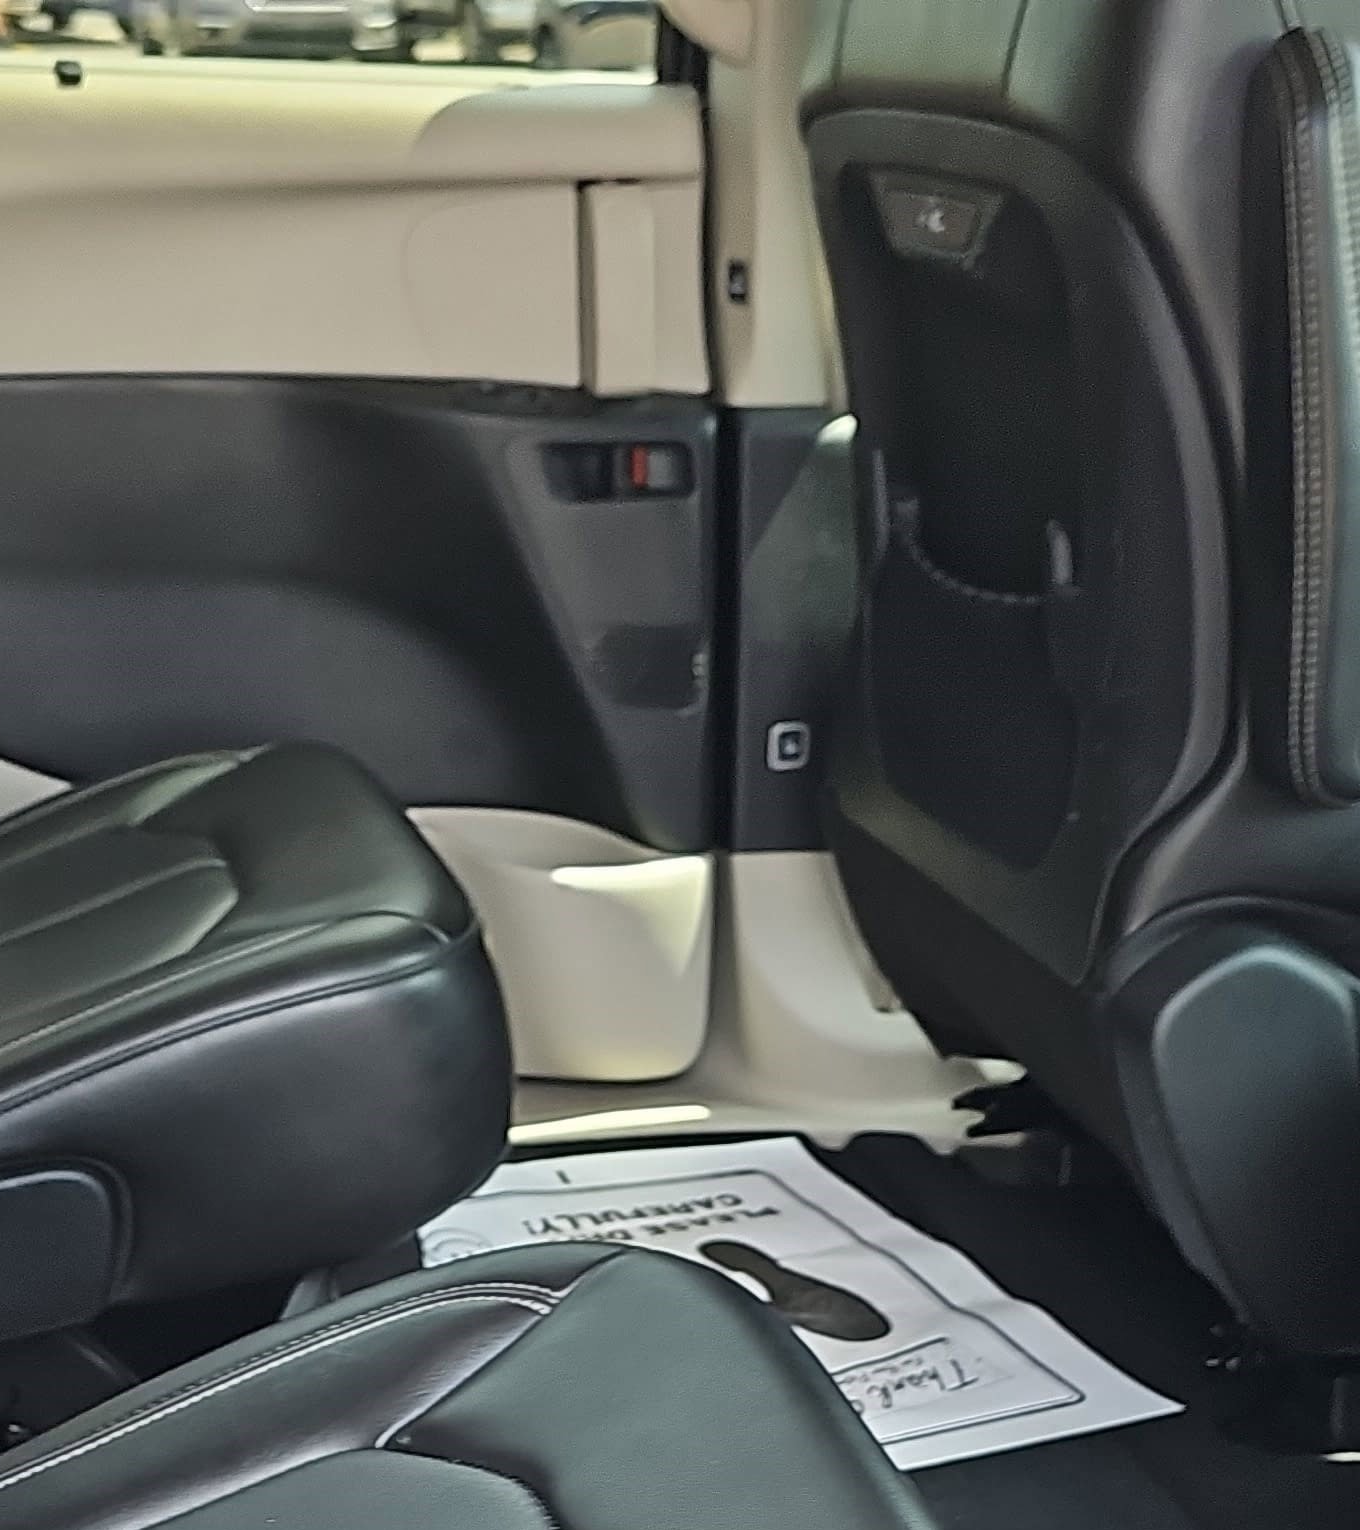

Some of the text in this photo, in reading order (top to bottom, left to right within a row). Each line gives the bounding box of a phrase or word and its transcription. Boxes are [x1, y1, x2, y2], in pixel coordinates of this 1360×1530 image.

[521, 1193, 743, 1236] CAREFULLY!
[642, 1206, 780, 1236] PLEASE
[867, 1359, 979, 1409] Thank
